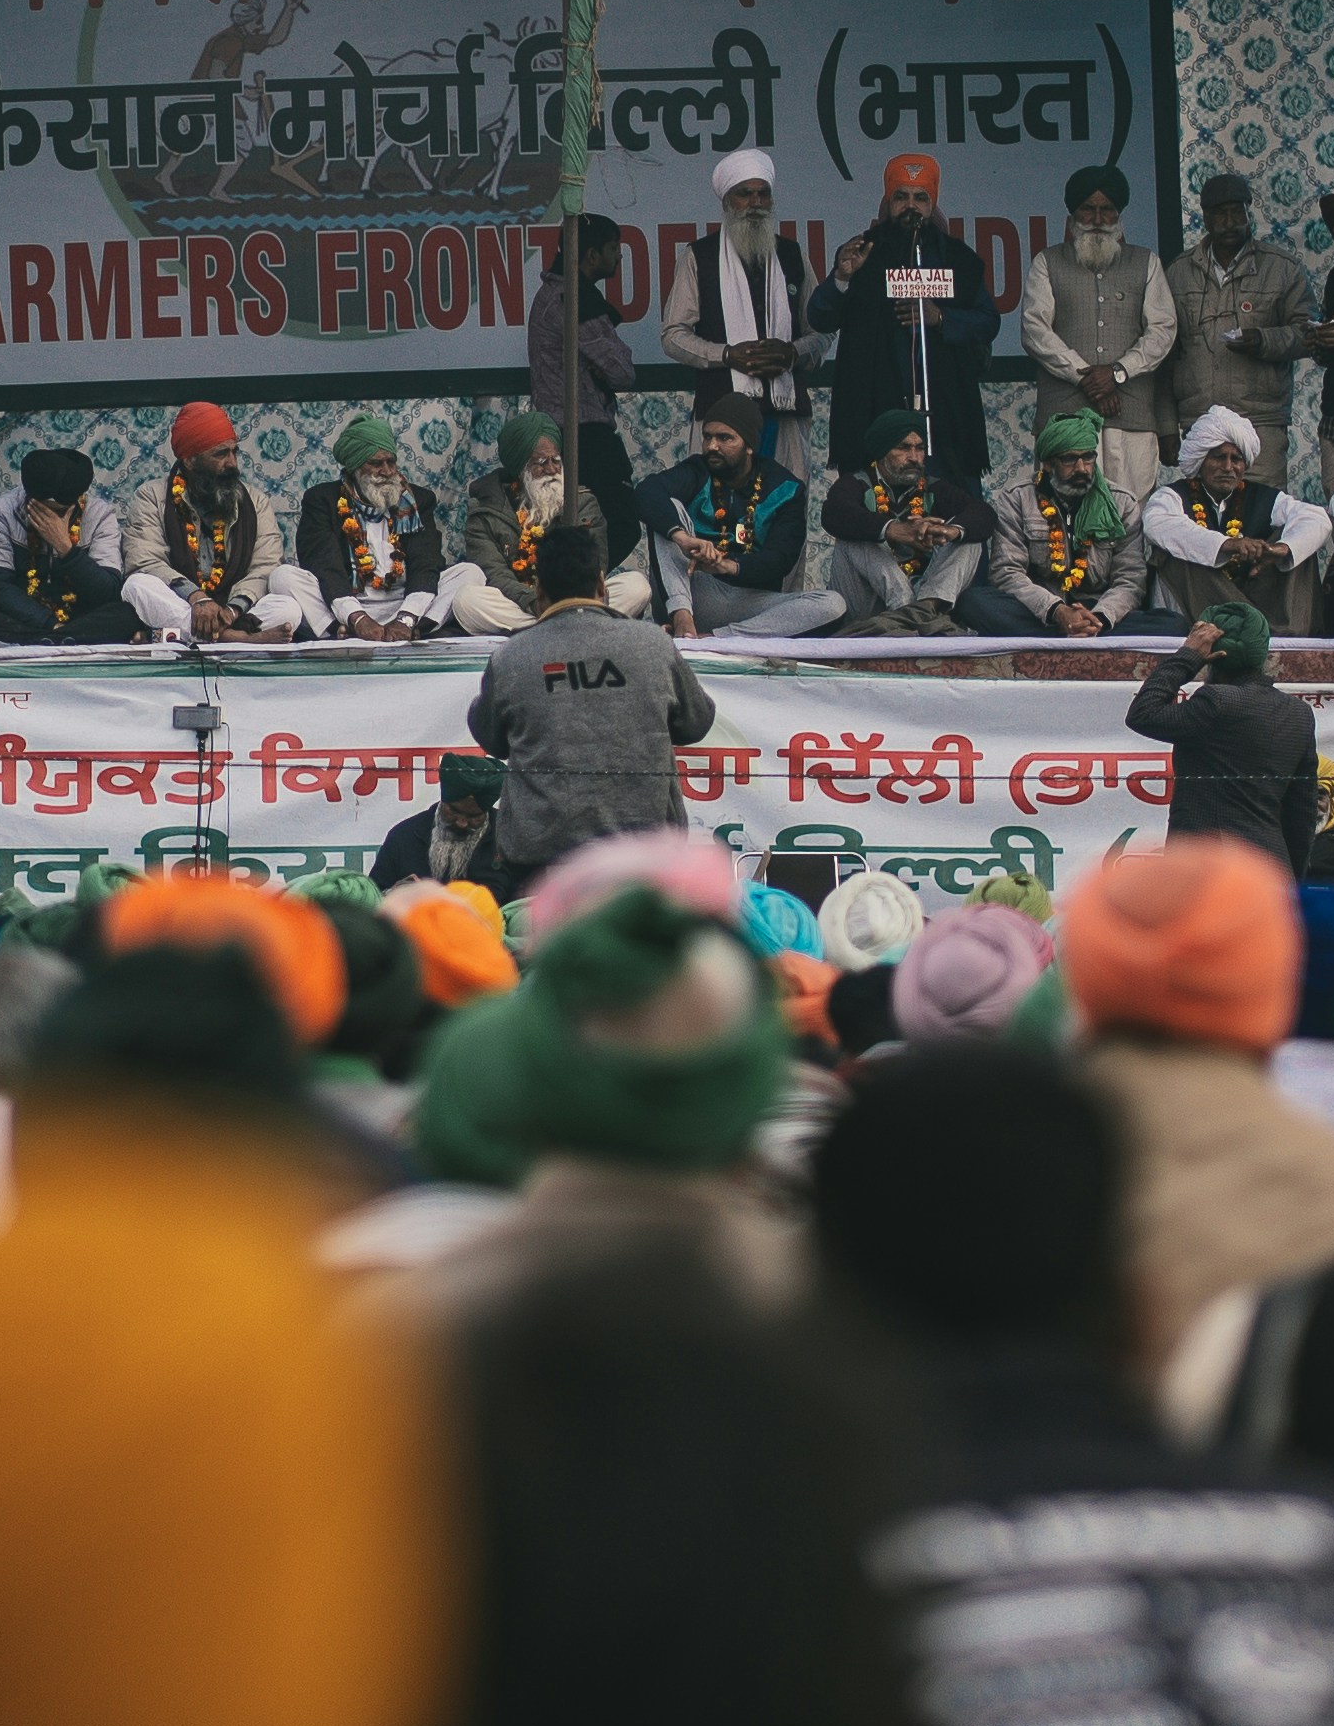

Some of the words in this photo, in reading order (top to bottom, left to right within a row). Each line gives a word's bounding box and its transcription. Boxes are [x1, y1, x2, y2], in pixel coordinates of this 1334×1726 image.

[264, 33, 485, 160] मोर्चा
[816, 23, 1133, 182] (भारत)
[887, 268, 923, 282] KAKA
[542, 658, 627, 693] FILA
[249, 732, 490, 804] ਕਿਸਾ
[777, 731, 984, 805] ਦਿੱਲੀ
[1008, 749, 1174, 815] (ਭਾਰ
